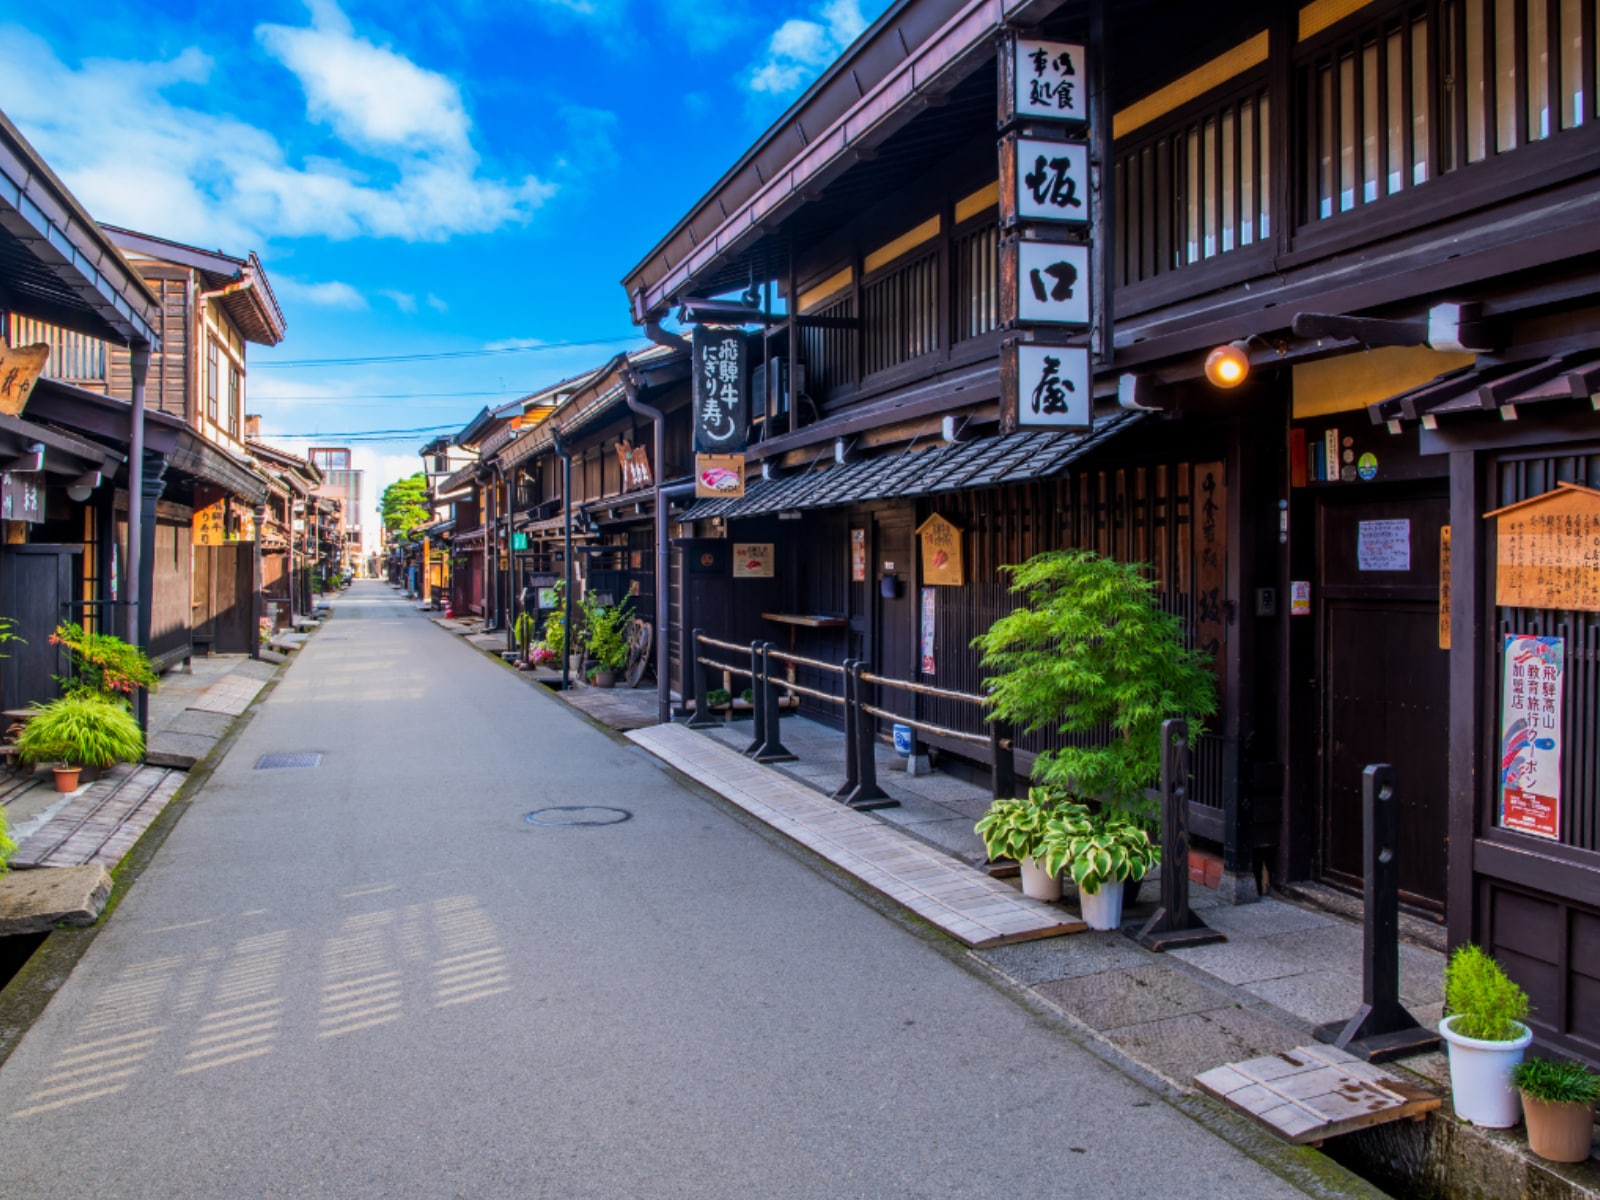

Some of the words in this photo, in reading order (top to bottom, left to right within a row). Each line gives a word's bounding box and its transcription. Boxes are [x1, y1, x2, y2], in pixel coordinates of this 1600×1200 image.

[718, 338, 739, 410] 飛騨牛
[1511, 663, 1525, 710] 加盟店
[1542, 665, 1557, 730] 飛騨高山
[1525, 664, 1540, 789] 教育旅行クーポン
